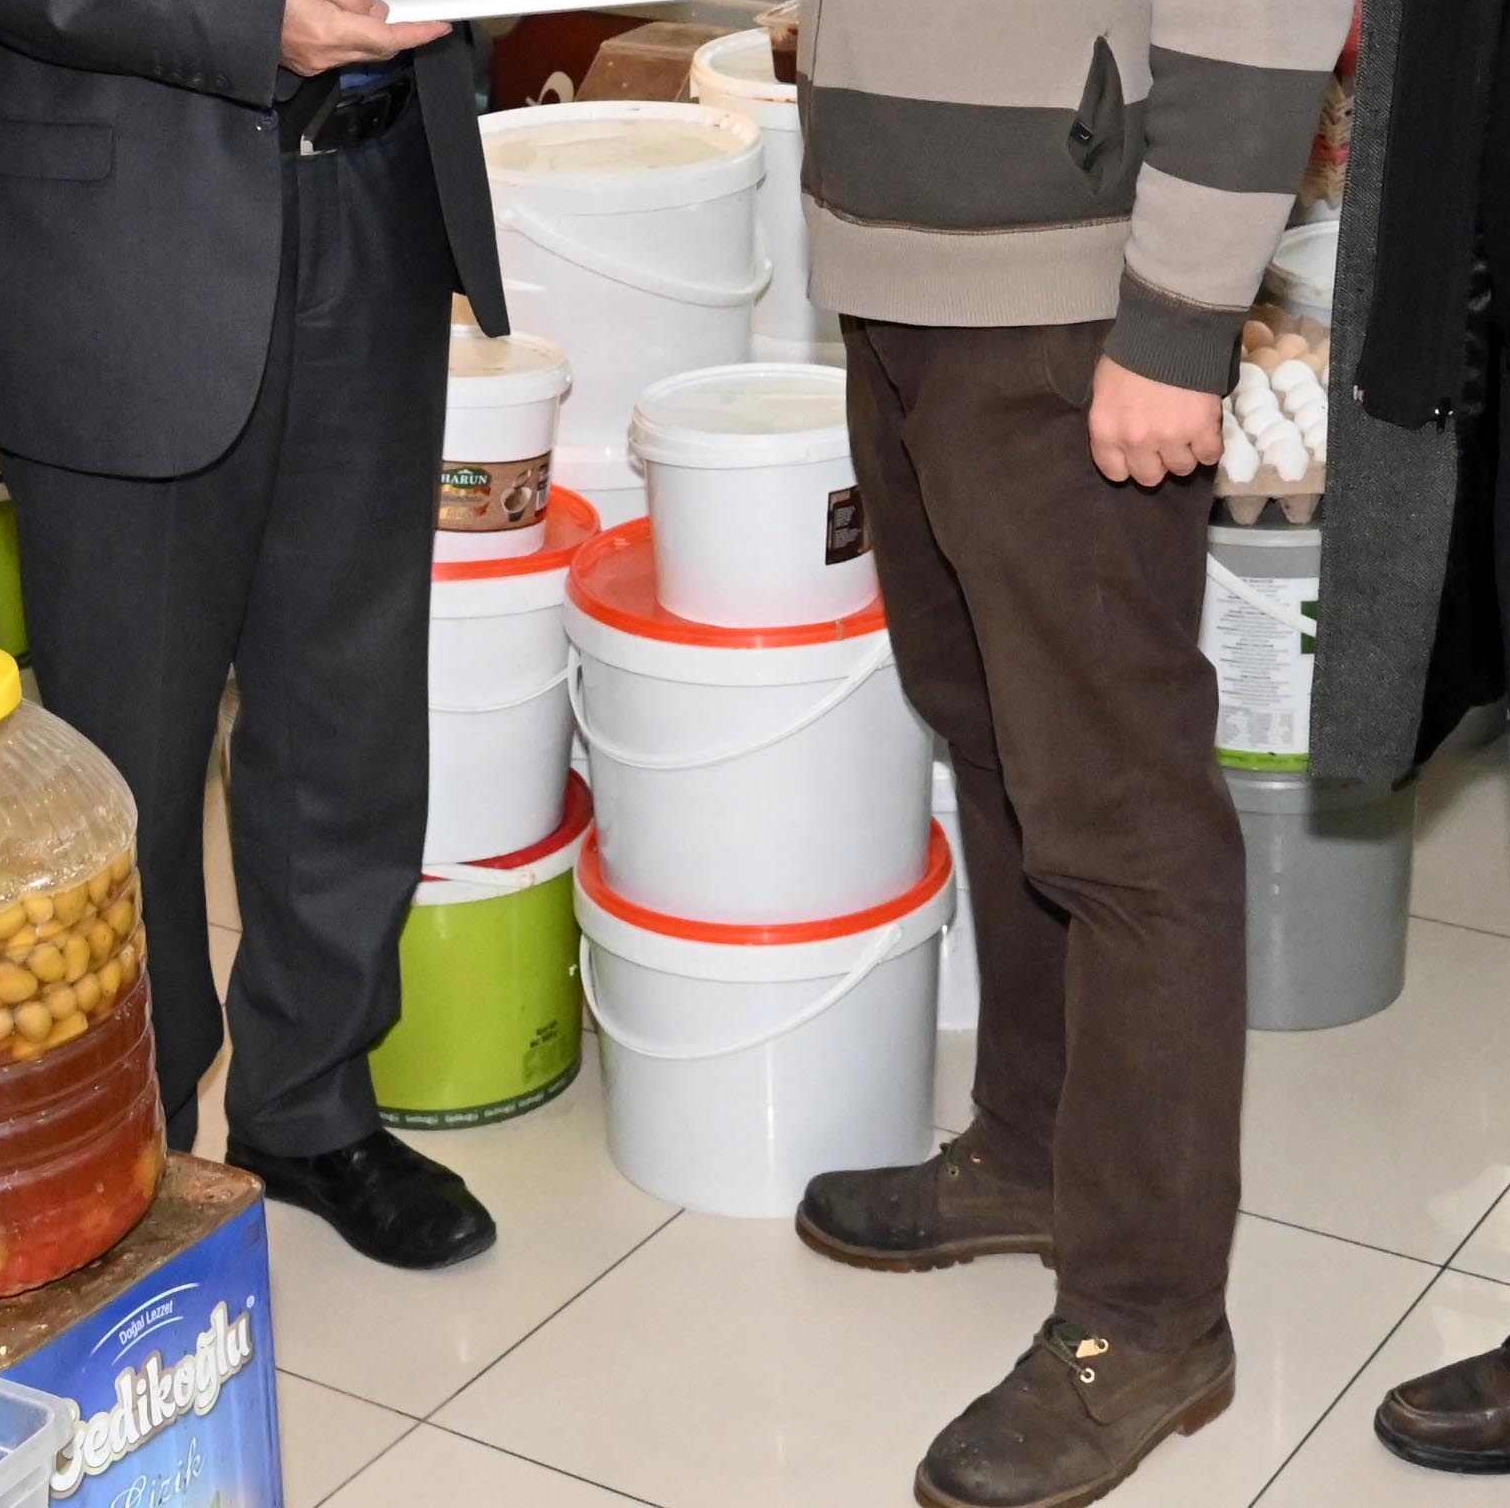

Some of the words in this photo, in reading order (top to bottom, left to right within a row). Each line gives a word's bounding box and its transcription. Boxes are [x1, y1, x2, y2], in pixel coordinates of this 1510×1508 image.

[441, 473, 488, 485] HARUN
[118, 1317, 145, 1346] Doğal
[146, 1299, 174, 1324] Lezzet
